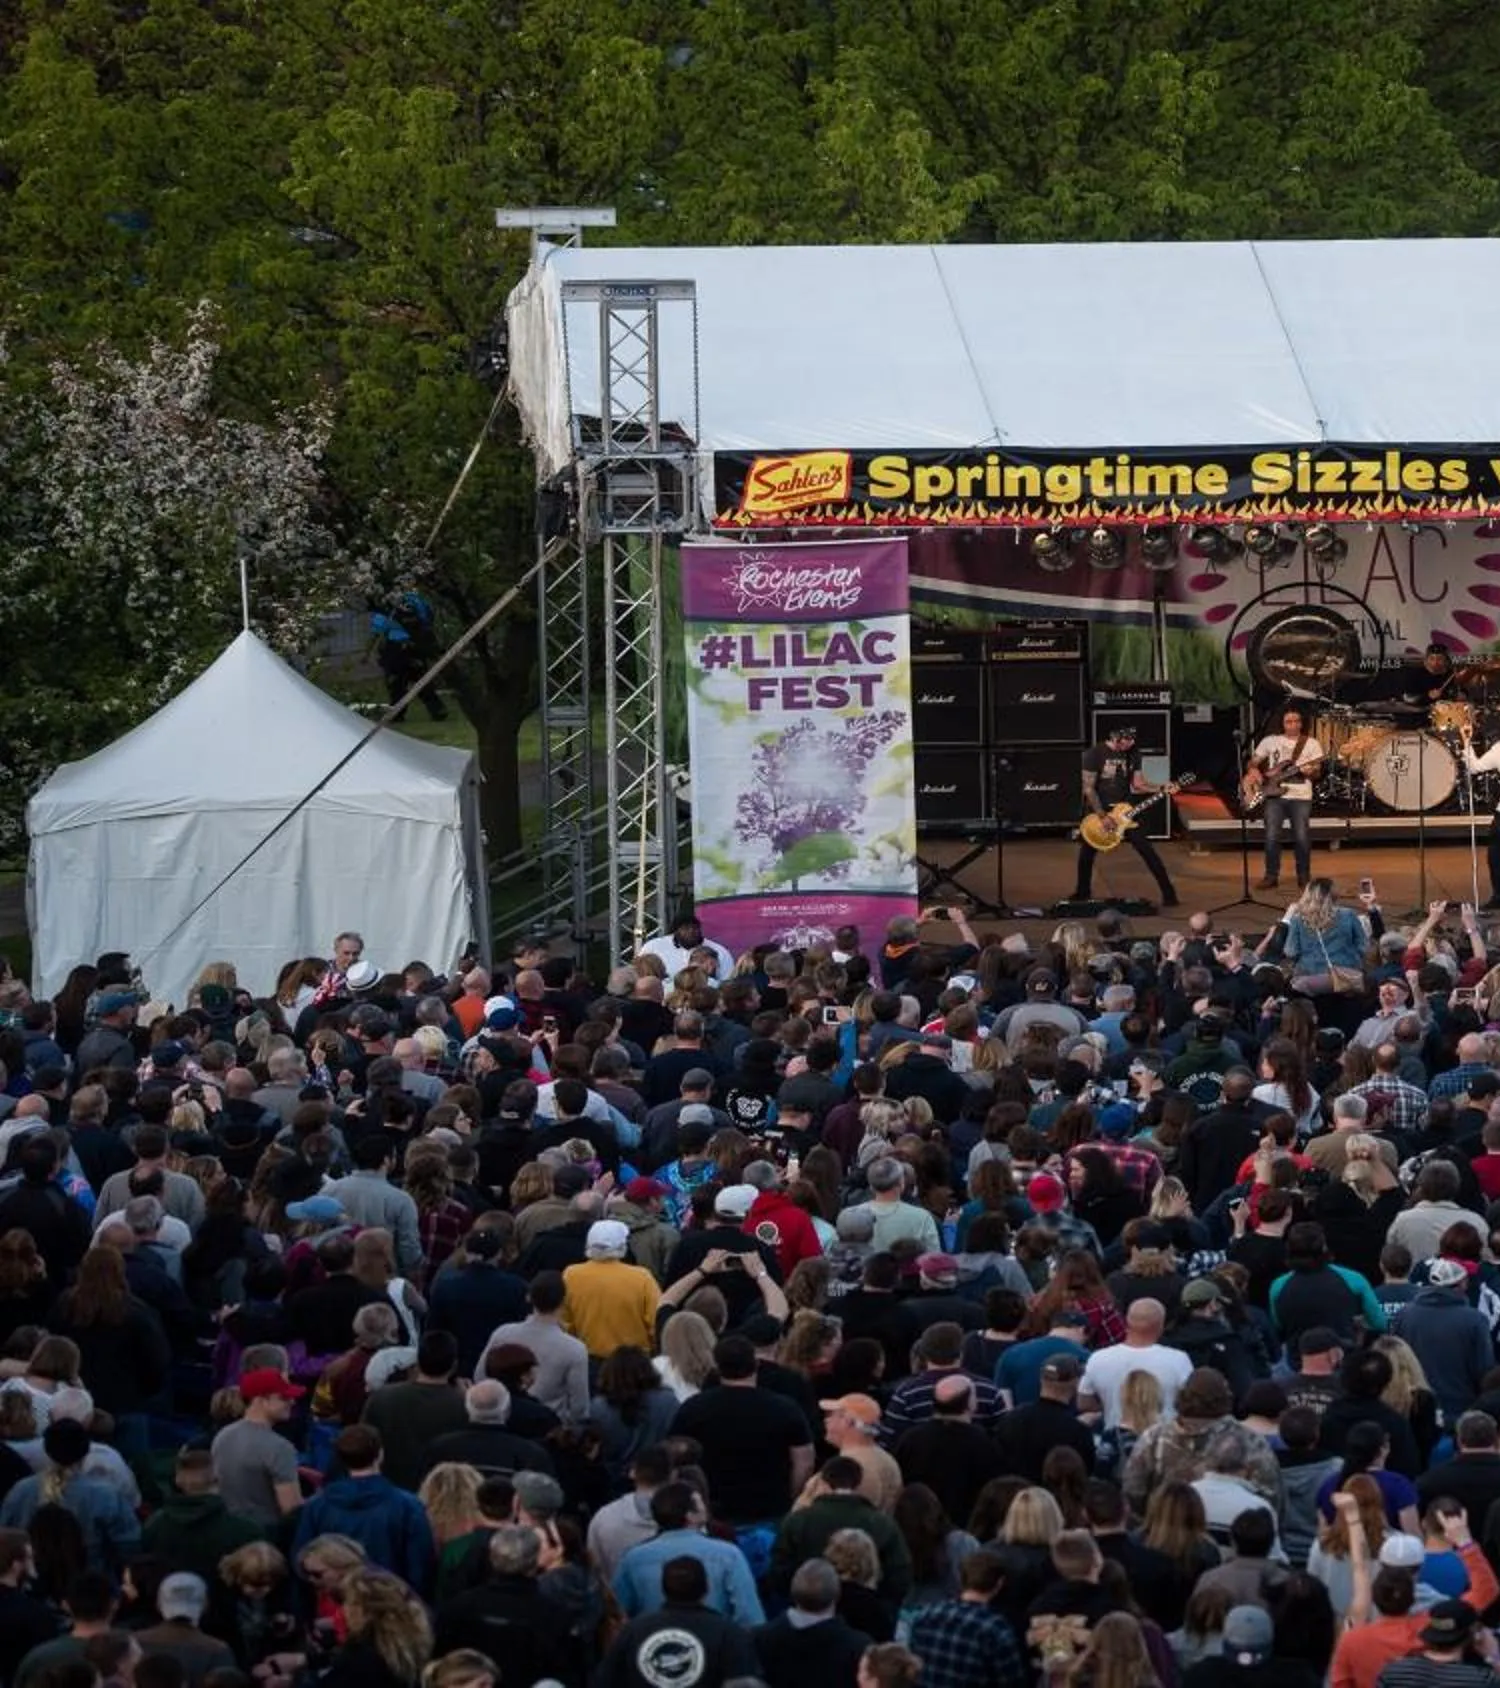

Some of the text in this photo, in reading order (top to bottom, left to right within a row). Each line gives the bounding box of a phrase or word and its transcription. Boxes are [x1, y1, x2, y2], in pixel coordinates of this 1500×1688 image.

[752, 461, 843, 500] Sahlen's
[867, 454, 1229, 503] Springtime
[1251, 452, 1469, 494] Sizzles
[739, 564, 862, 592] Rochester
[783, 586, 863, 611] Events
[700, 630, 897, 669] #LILAC
[748, 674, 883, 711] FEST
